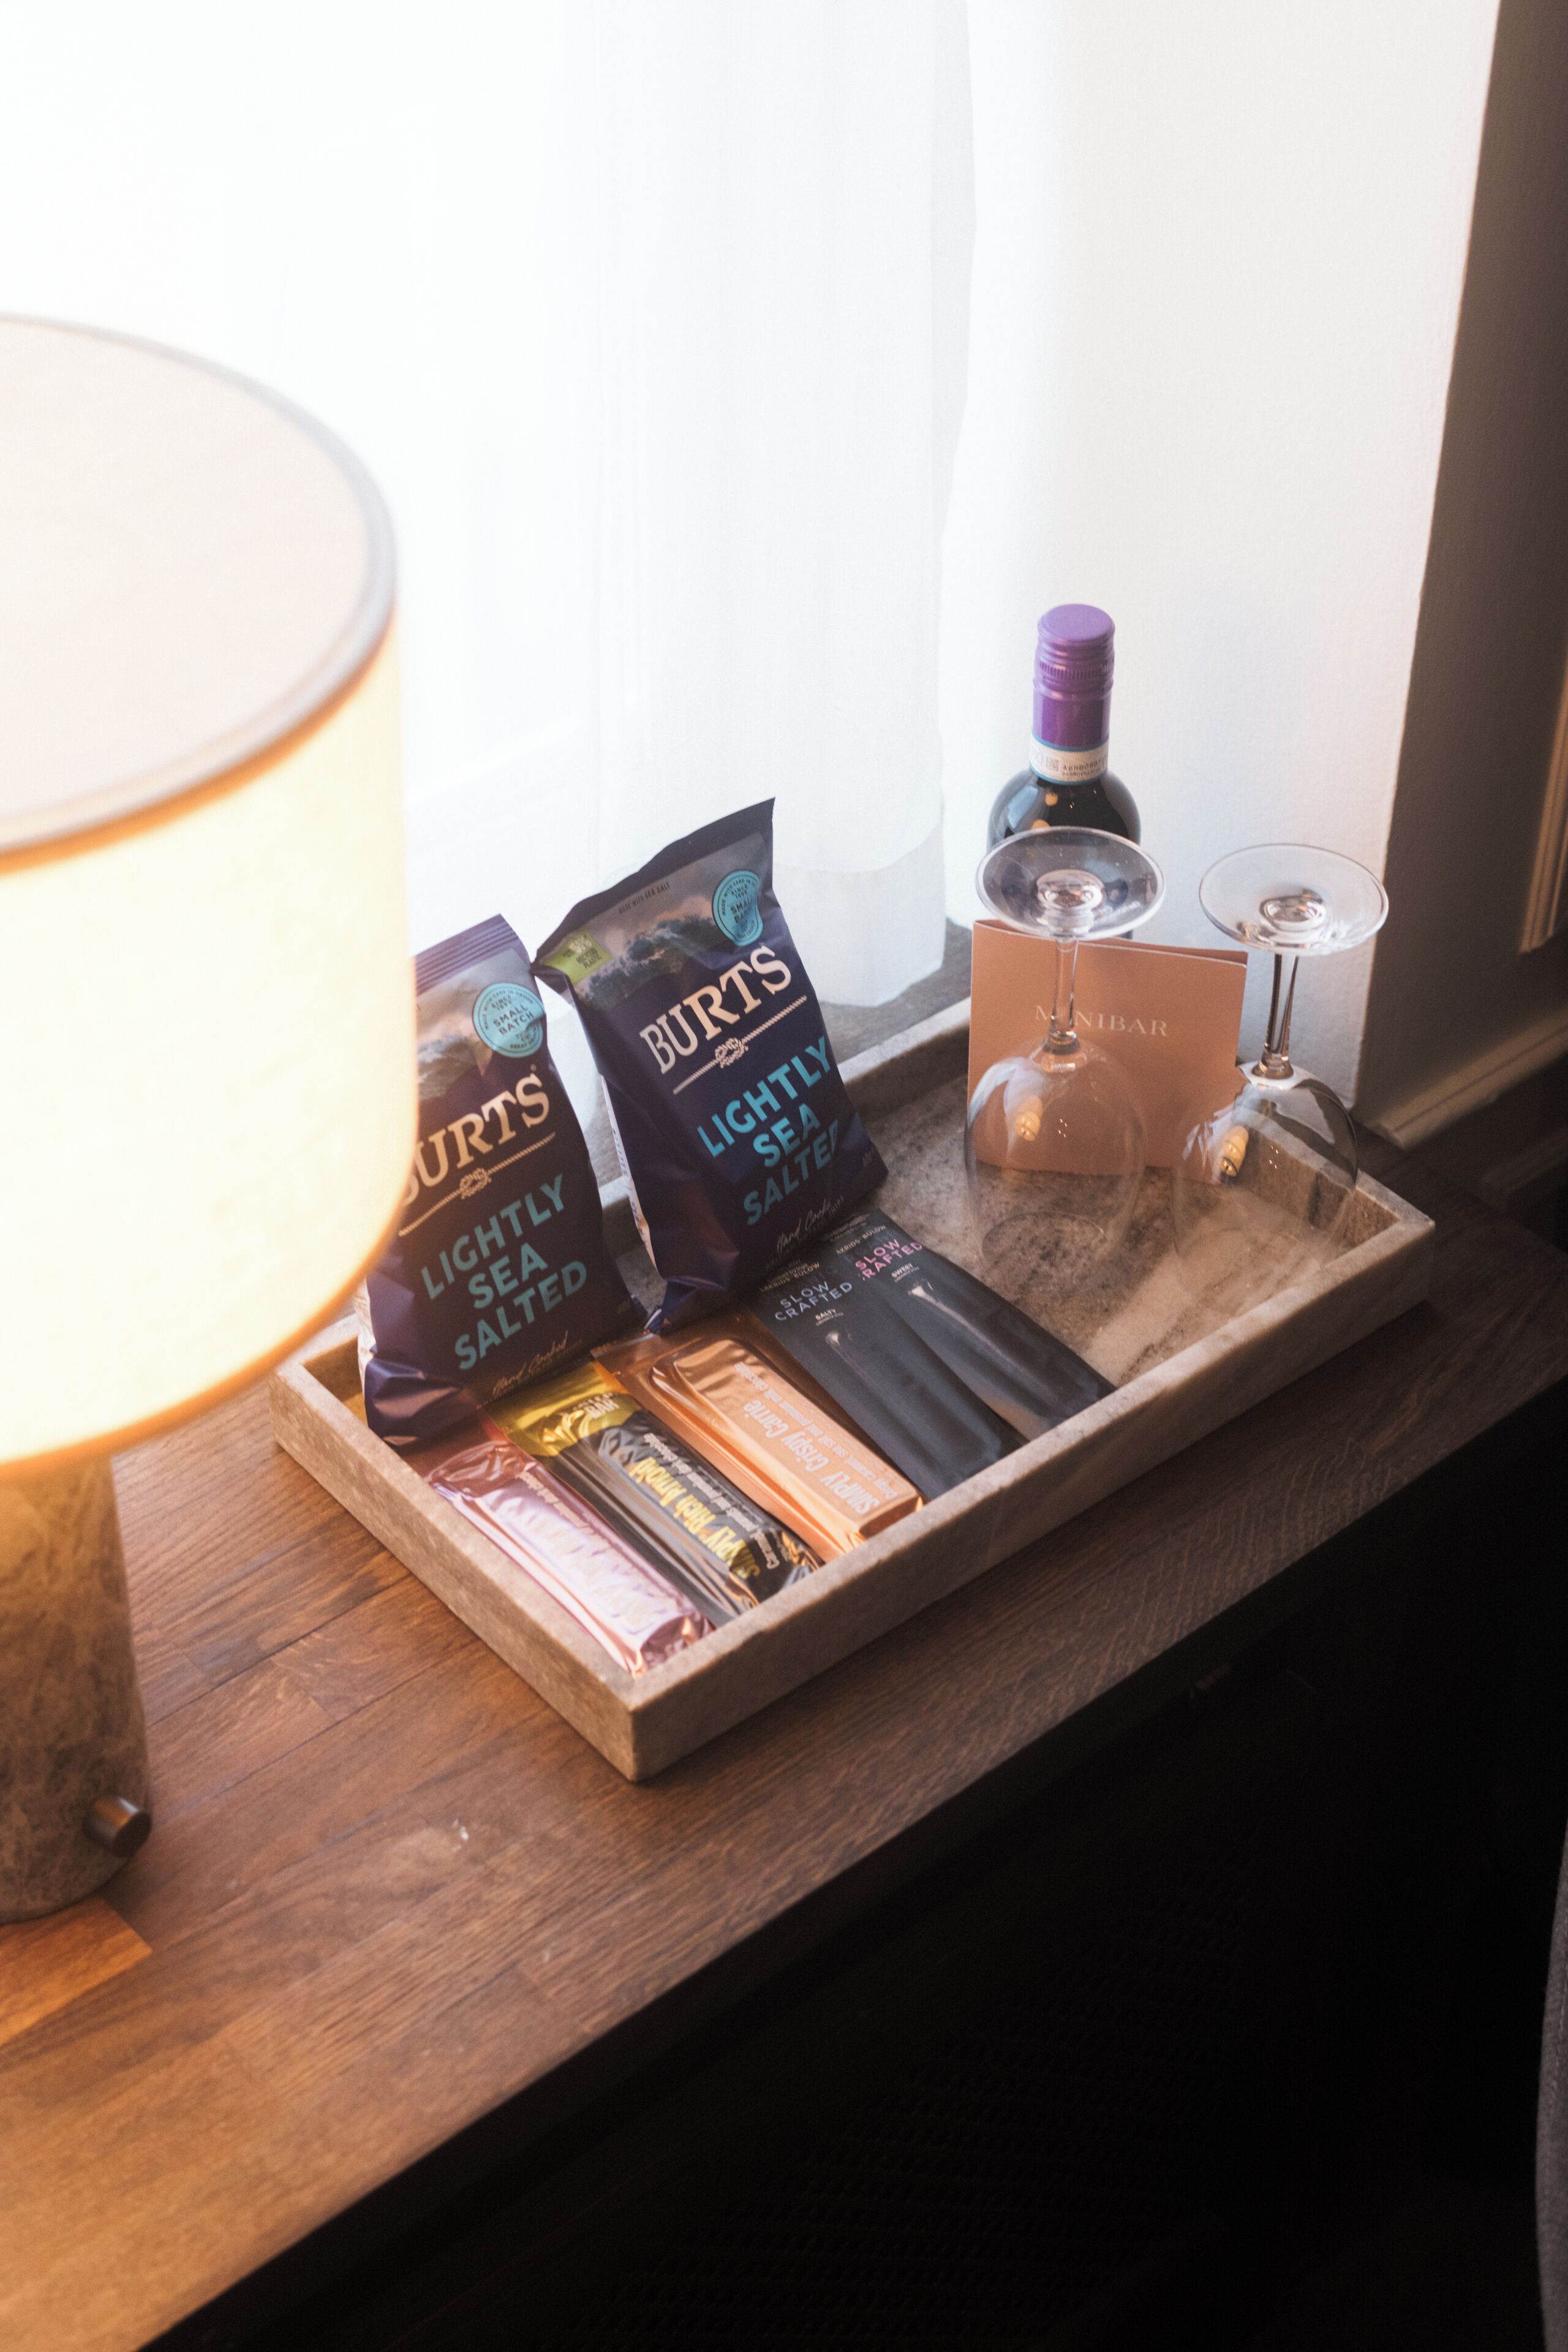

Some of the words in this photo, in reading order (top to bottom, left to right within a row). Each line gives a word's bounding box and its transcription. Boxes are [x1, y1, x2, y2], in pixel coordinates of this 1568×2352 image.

[493, 1004, 529, 1027] SMALL
[499, 1011, 535, 1036] BATCH
[639, 945, 792, 1075] BURTS
[1035, 1005, 1170, 1037] MNIBAR
[696, 1035, 831, 1158] LIGHTLY
[753, 1102, 821, 1167] SEA
[421, 1172, 565, 1301] LIGHTLY
[835, 1239, 861, 1256] AKRIDS
[854, 1238, 901, 1271] SLOW
[861, 1242, 923, 1281] RAFTED
[467, 1242, 549, 1310] SEA
[891, 1262, 914, 1279] SWEET
[774, 1281, 853, 1322] CRAFTED
[780, 1281, 829, 1310] SLOW
[454, 1260, 587, 1370] SALTED
[815, 1308, 837, 1321] SALTY
[734, 1361, 769, 1392] chocolate
[583, 1393, 620, 1419] BAR
[764, 1388, 784, 1404] milk
[743, 1399, 790, 1439] Carrie
[778, 1400, 813, 1428] premium
[643, 1432, 679, 1462] chocolate
[780, 1430, 830, 1473] Crispy
[817, 1434, 836, 1449] salt
[832, 1444, 848, 1458] sea
[628, 1456, 688, 1507] Arnold
[671, 1458, 693, 1476] dark
[686, 1471, 723, 1501] premium
[819, 1470, 881, 1515] SIMPLY
[873, 1476, 899, 1500] Crispy
[673, 1493, 717, 1536] Rich
